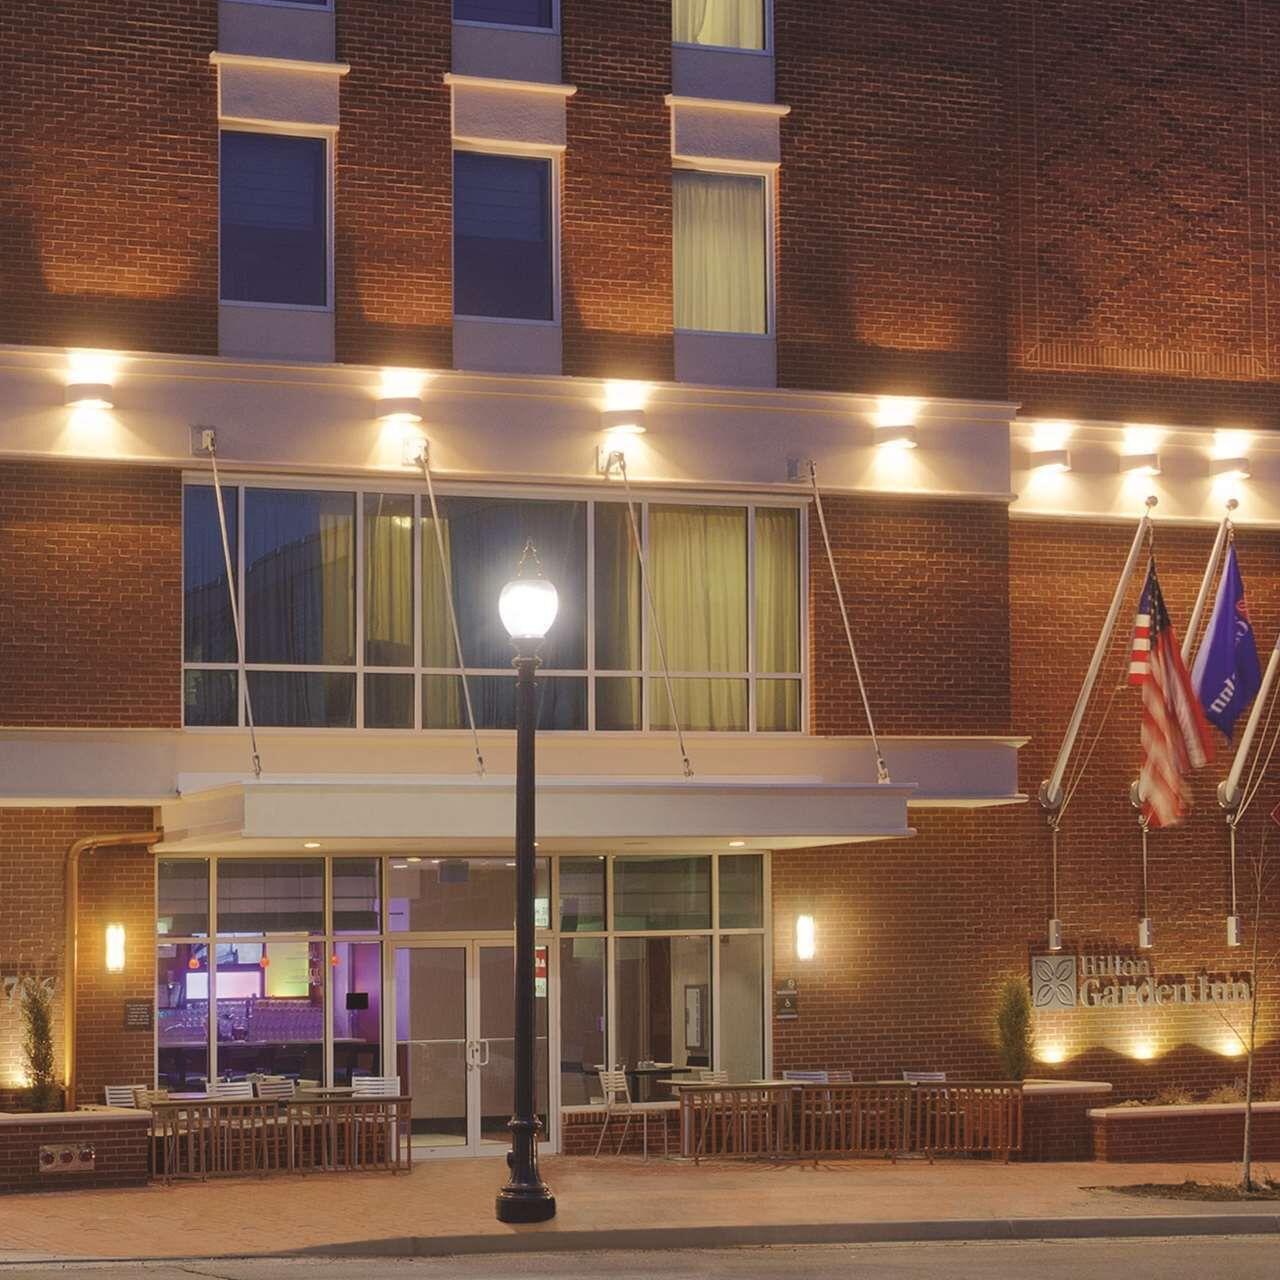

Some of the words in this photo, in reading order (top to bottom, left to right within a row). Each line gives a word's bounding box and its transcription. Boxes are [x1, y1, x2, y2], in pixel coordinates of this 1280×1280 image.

[1080, 954, 1150, 977] Hilton
[1079, 976, 1193, 1008] Garden
[1199, 974, 1253, 1003] Inn
